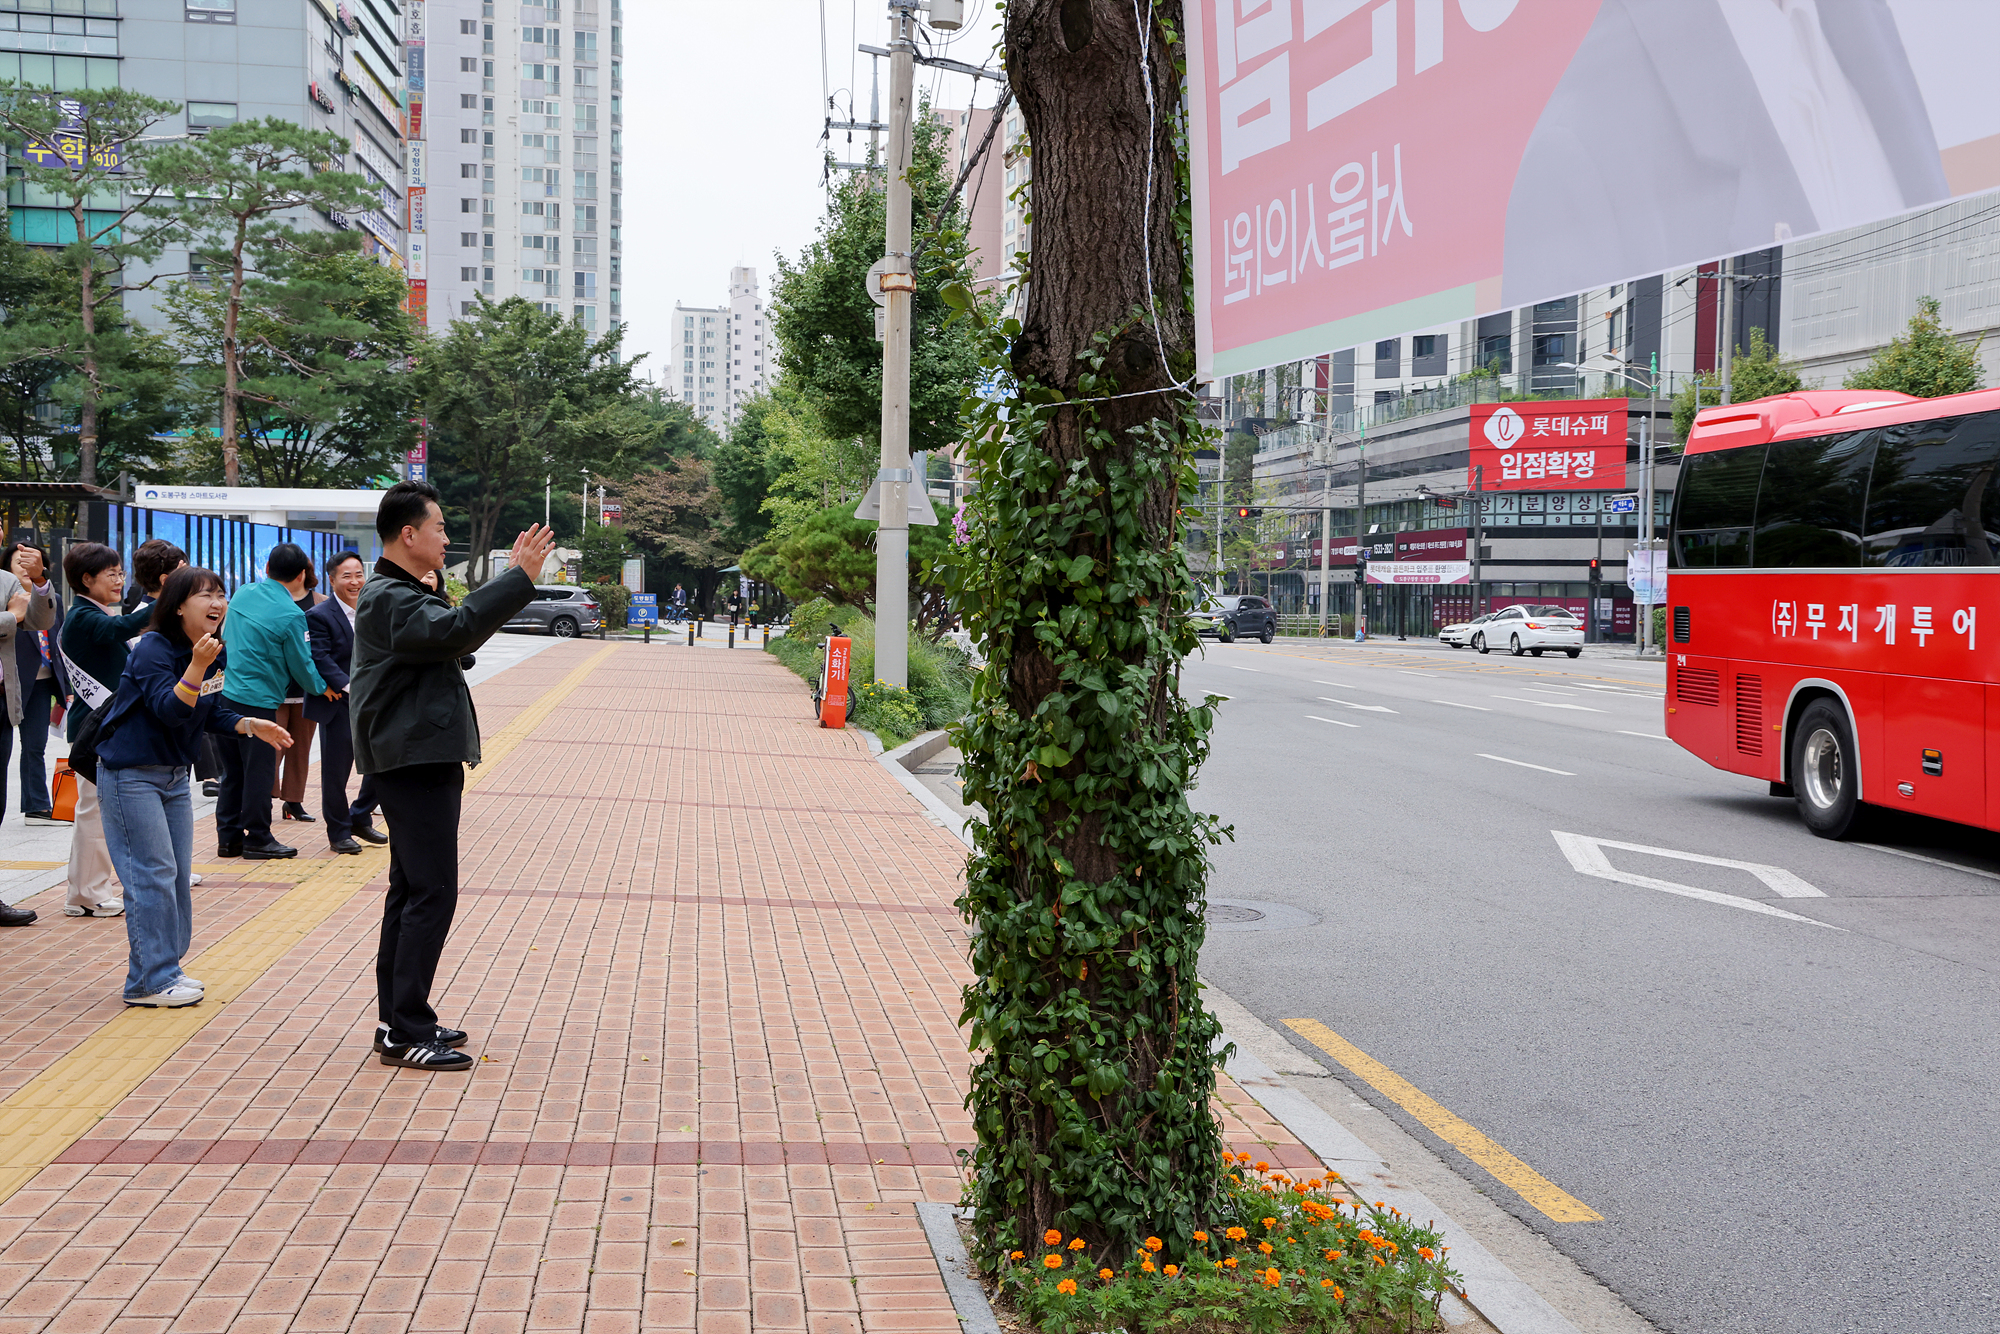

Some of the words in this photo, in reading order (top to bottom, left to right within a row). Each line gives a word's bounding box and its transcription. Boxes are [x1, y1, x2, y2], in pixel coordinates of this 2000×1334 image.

[27, 137, 87, 165] 수학
[411, 147, 421, 185] 정형외과
[1532, 415, 1609, 437] 롯데슈퍼
[1499, 450, 1596, 480] 입점확정
[161, 491, 187, 500] 도봉구청
[189, 492, 228, 500] 스마트도서관
[1370, 564, 1392, 573] 롯데캐슬
[1393, 564, 1415, 573] 골든파크
[831, 647, 843, 681] 소화기
[1676, 653, 1686, 667] 전세
